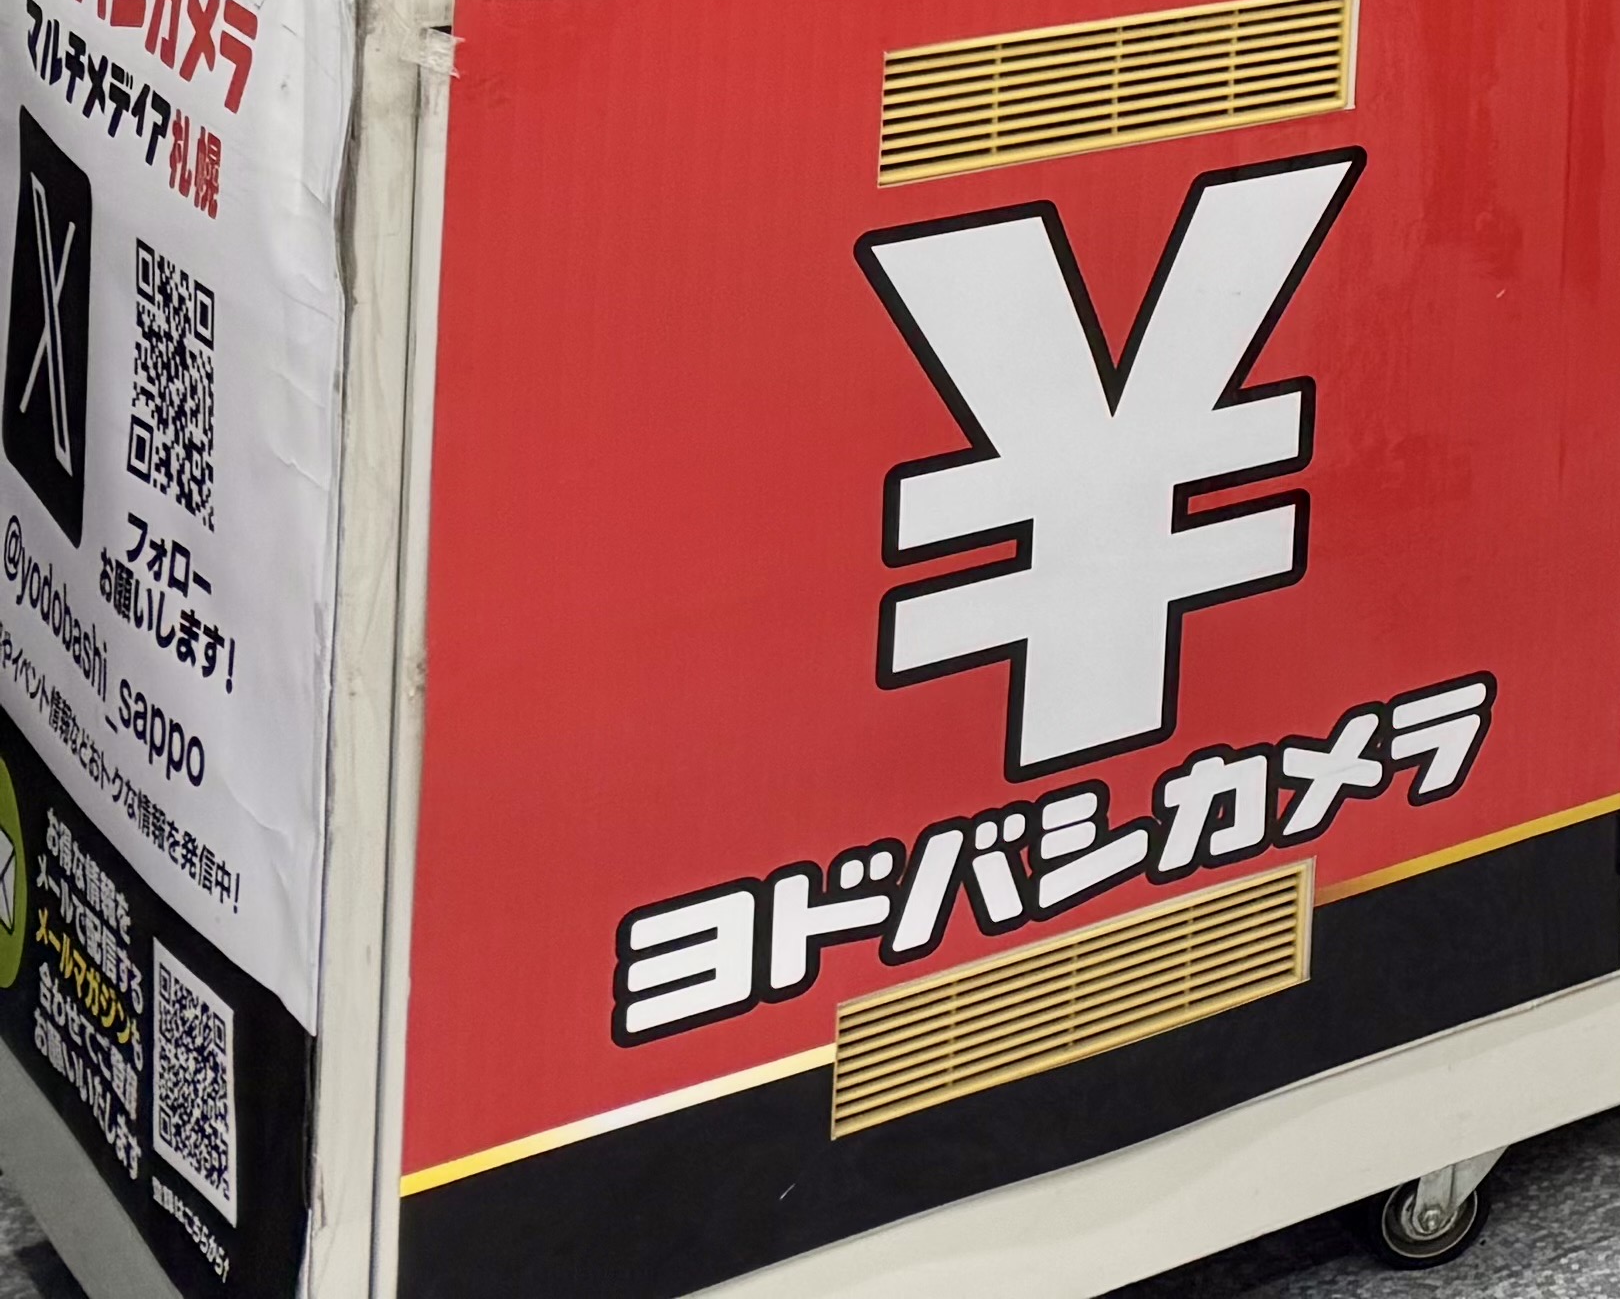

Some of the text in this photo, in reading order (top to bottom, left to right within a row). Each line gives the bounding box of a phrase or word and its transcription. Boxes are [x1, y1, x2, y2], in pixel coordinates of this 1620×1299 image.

[3, 514, 206, 787] @yodobashi_sappo
[99, 547, 236, 695] お願いします!
[127, 512, 213, 596] フォロー
[611, 671, 1497, 1047] ヨドバシカメラ
